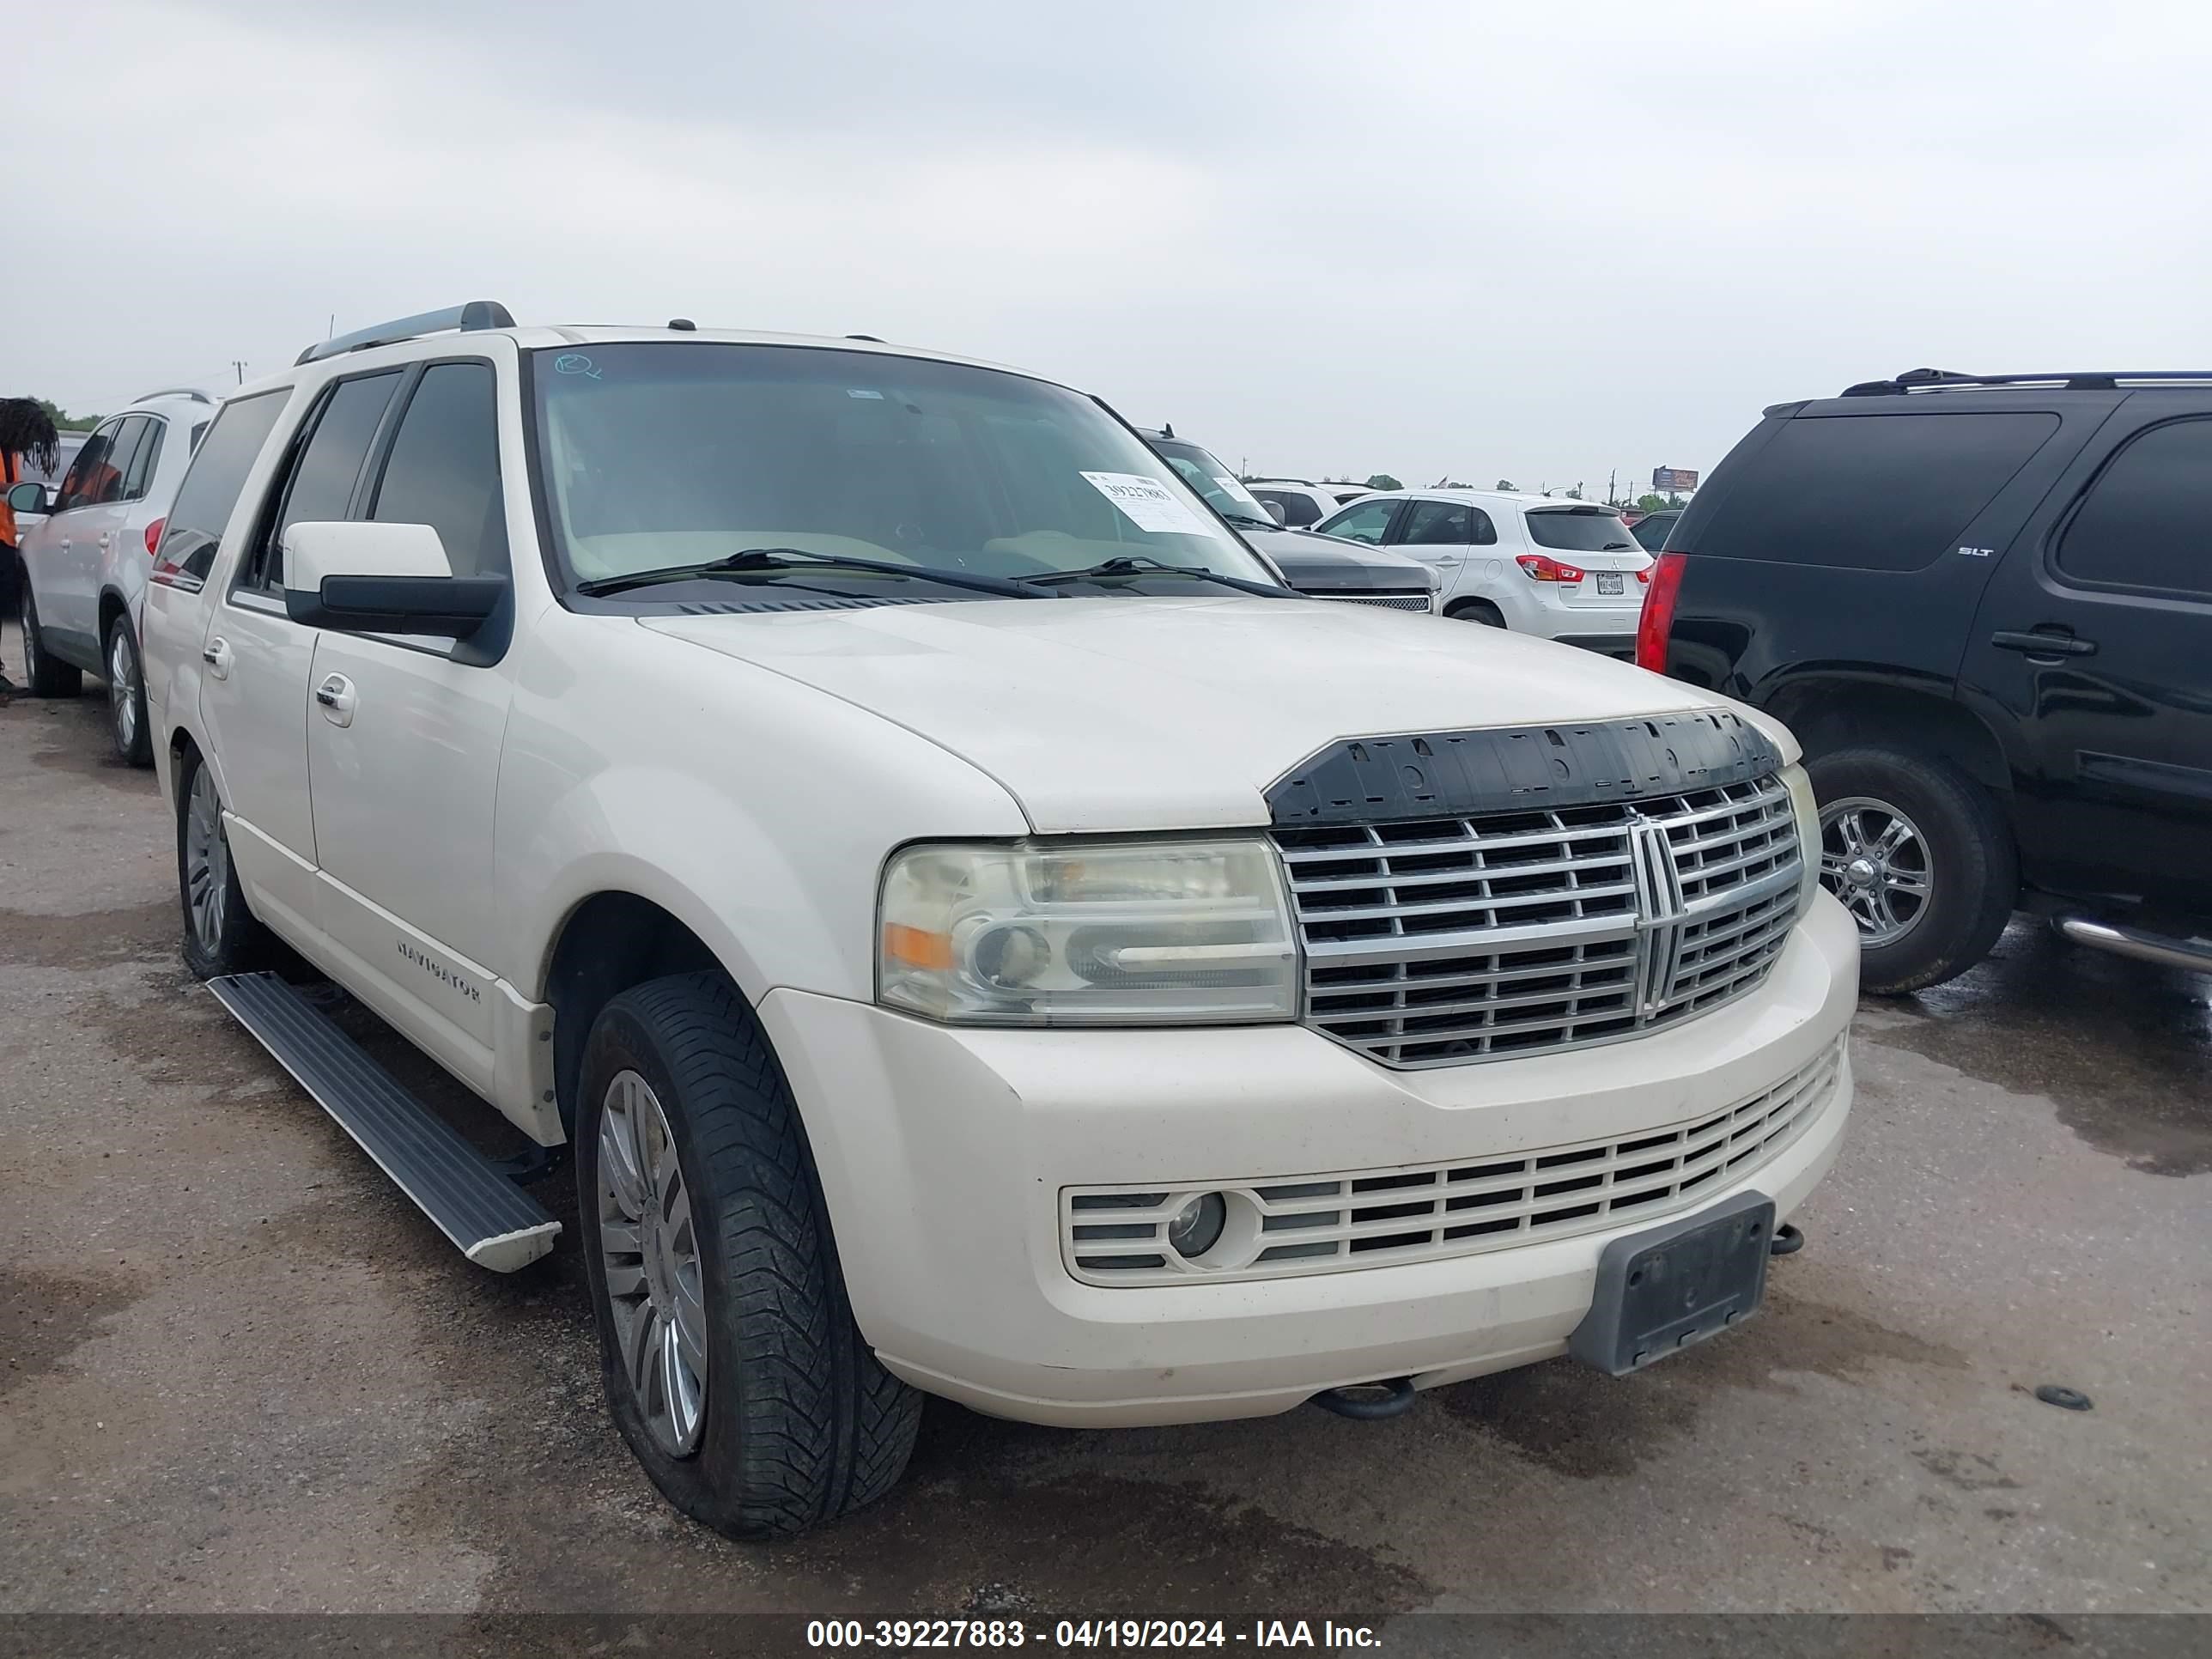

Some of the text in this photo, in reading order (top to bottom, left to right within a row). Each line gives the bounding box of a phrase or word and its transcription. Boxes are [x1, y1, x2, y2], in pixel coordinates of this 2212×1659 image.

[1104, 484, 1171, 501] 39227883
[1957, 546, 1994, 556] SLT
[397, 940, 481, 1004] NAVIGATOR
